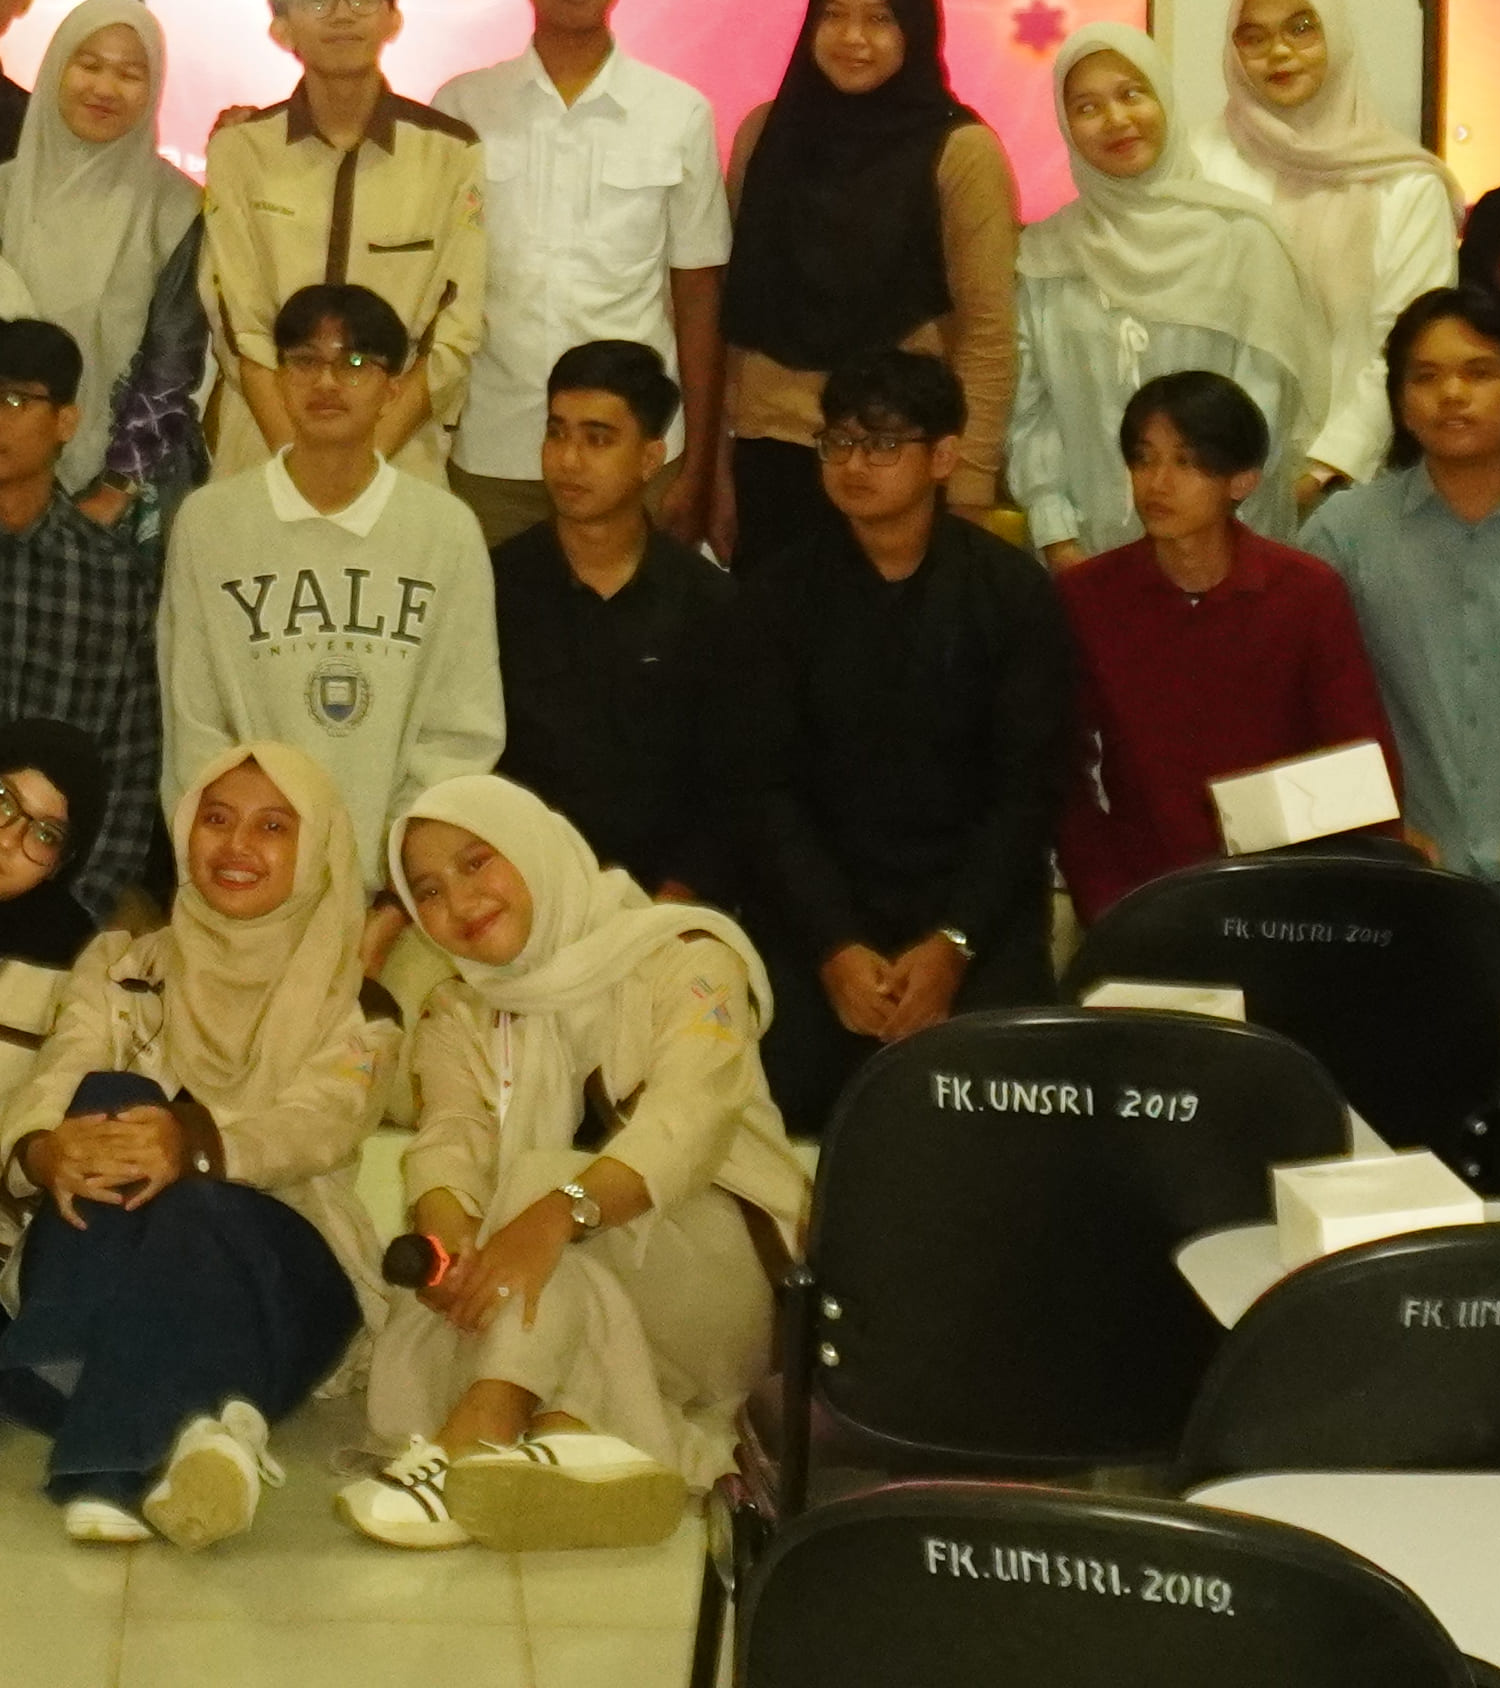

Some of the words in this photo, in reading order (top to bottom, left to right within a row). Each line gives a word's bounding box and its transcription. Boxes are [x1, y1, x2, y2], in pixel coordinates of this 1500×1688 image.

[220, 567, 437, 647] YALE
[251, 639, 409, 661] UNIVERSIT
[1119, 1090, 1200, 1123] 2019
